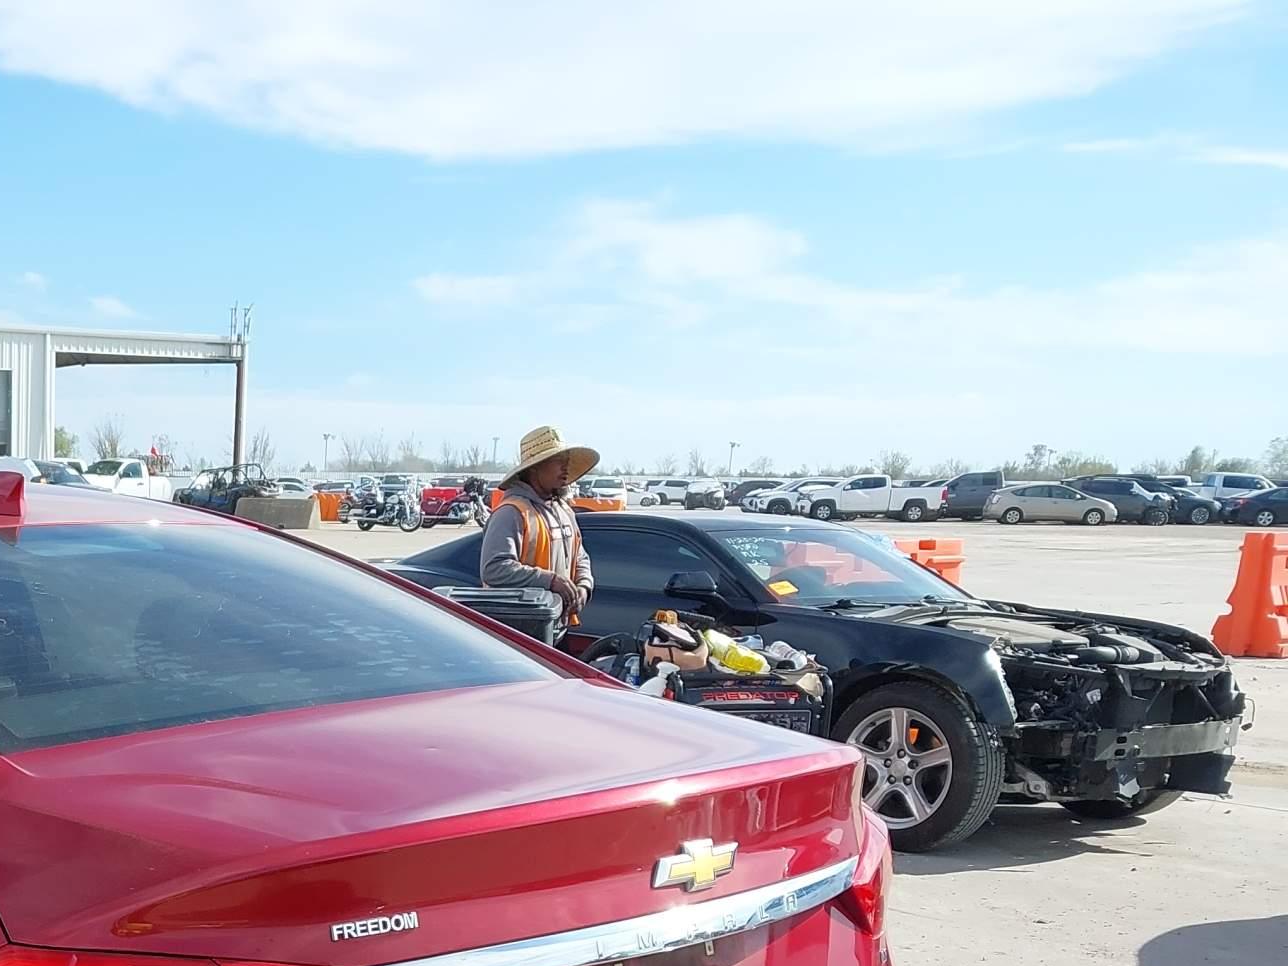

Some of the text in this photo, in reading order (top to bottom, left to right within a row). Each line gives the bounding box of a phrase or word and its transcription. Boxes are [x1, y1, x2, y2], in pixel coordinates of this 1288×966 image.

[701, 690, 800, 702] PREDATOR
[330, 911, 419, 942] FREEDOM
[595, 892, 799, 960] IMPALA
